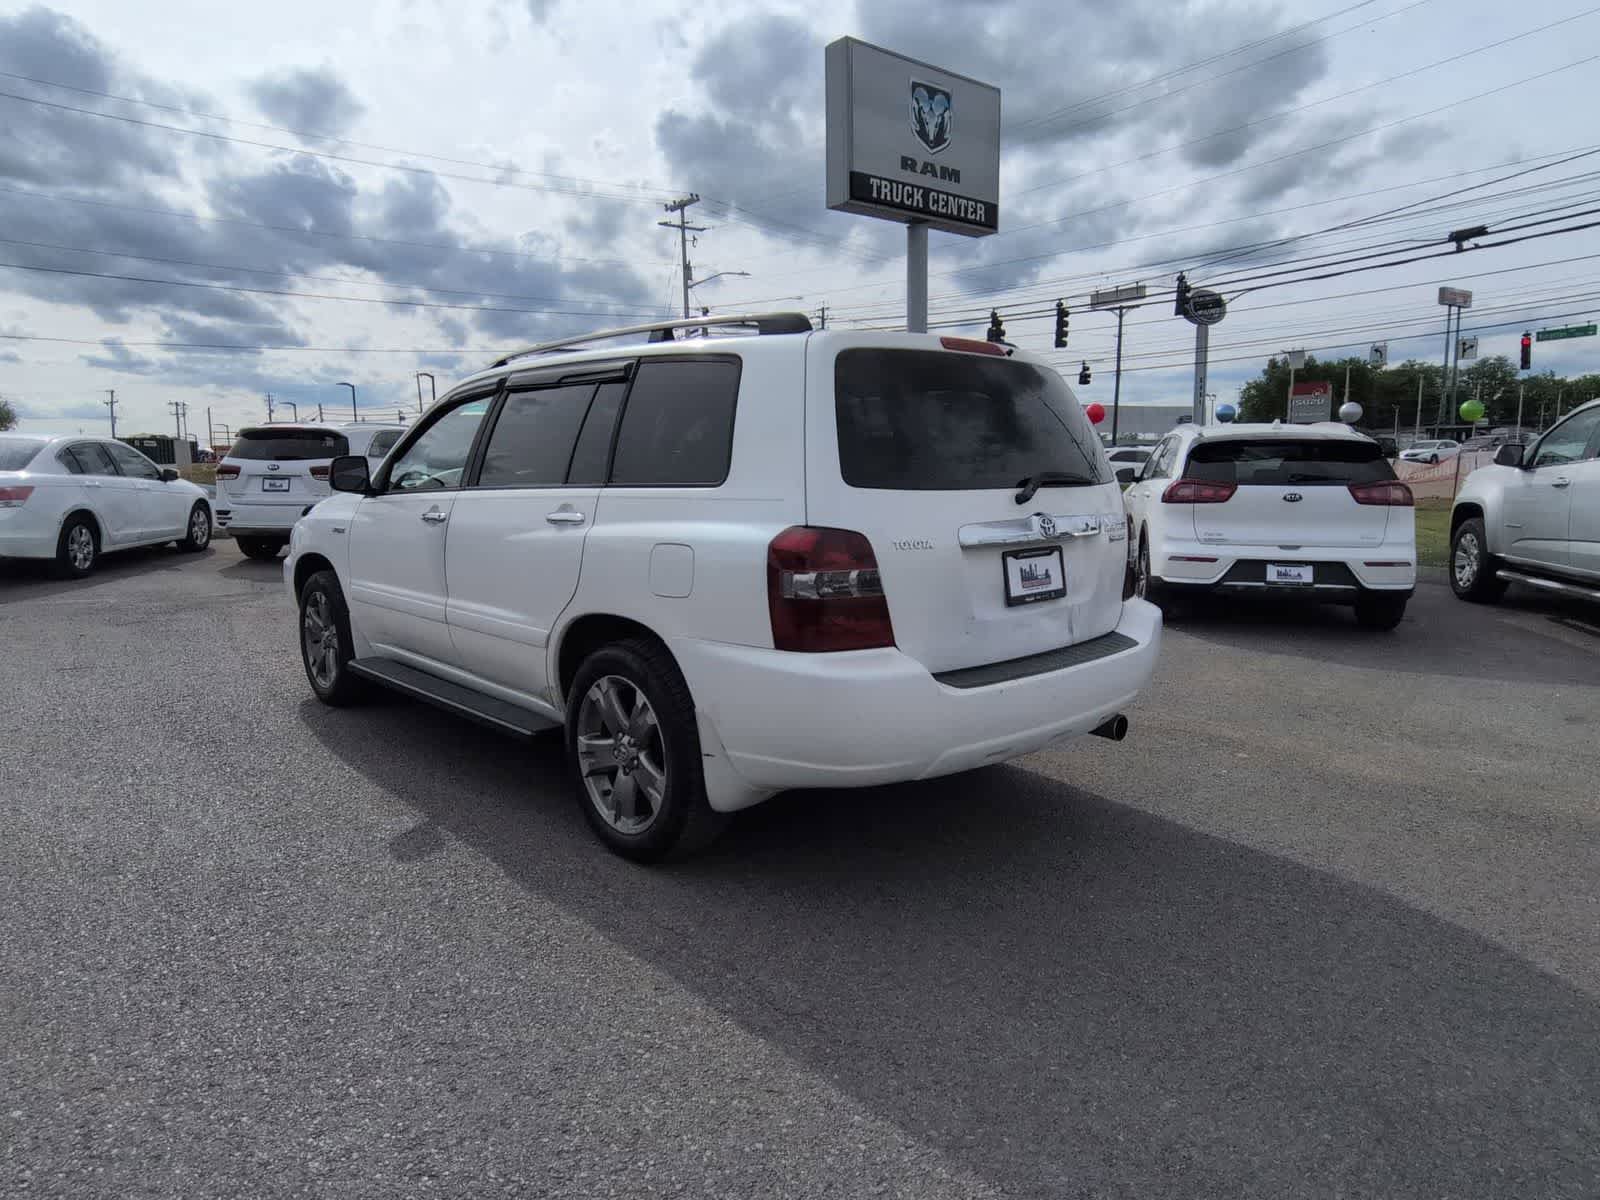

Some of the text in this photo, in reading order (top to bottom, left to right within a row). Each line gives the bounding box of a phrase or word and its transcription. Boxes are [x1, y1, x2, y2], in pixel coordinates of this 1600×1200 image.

[900, 155, 961, 184] RAM
[869, 176, 986, 223] TRUCK CENTER
[892, 540, 935, 551] TOYOTA
